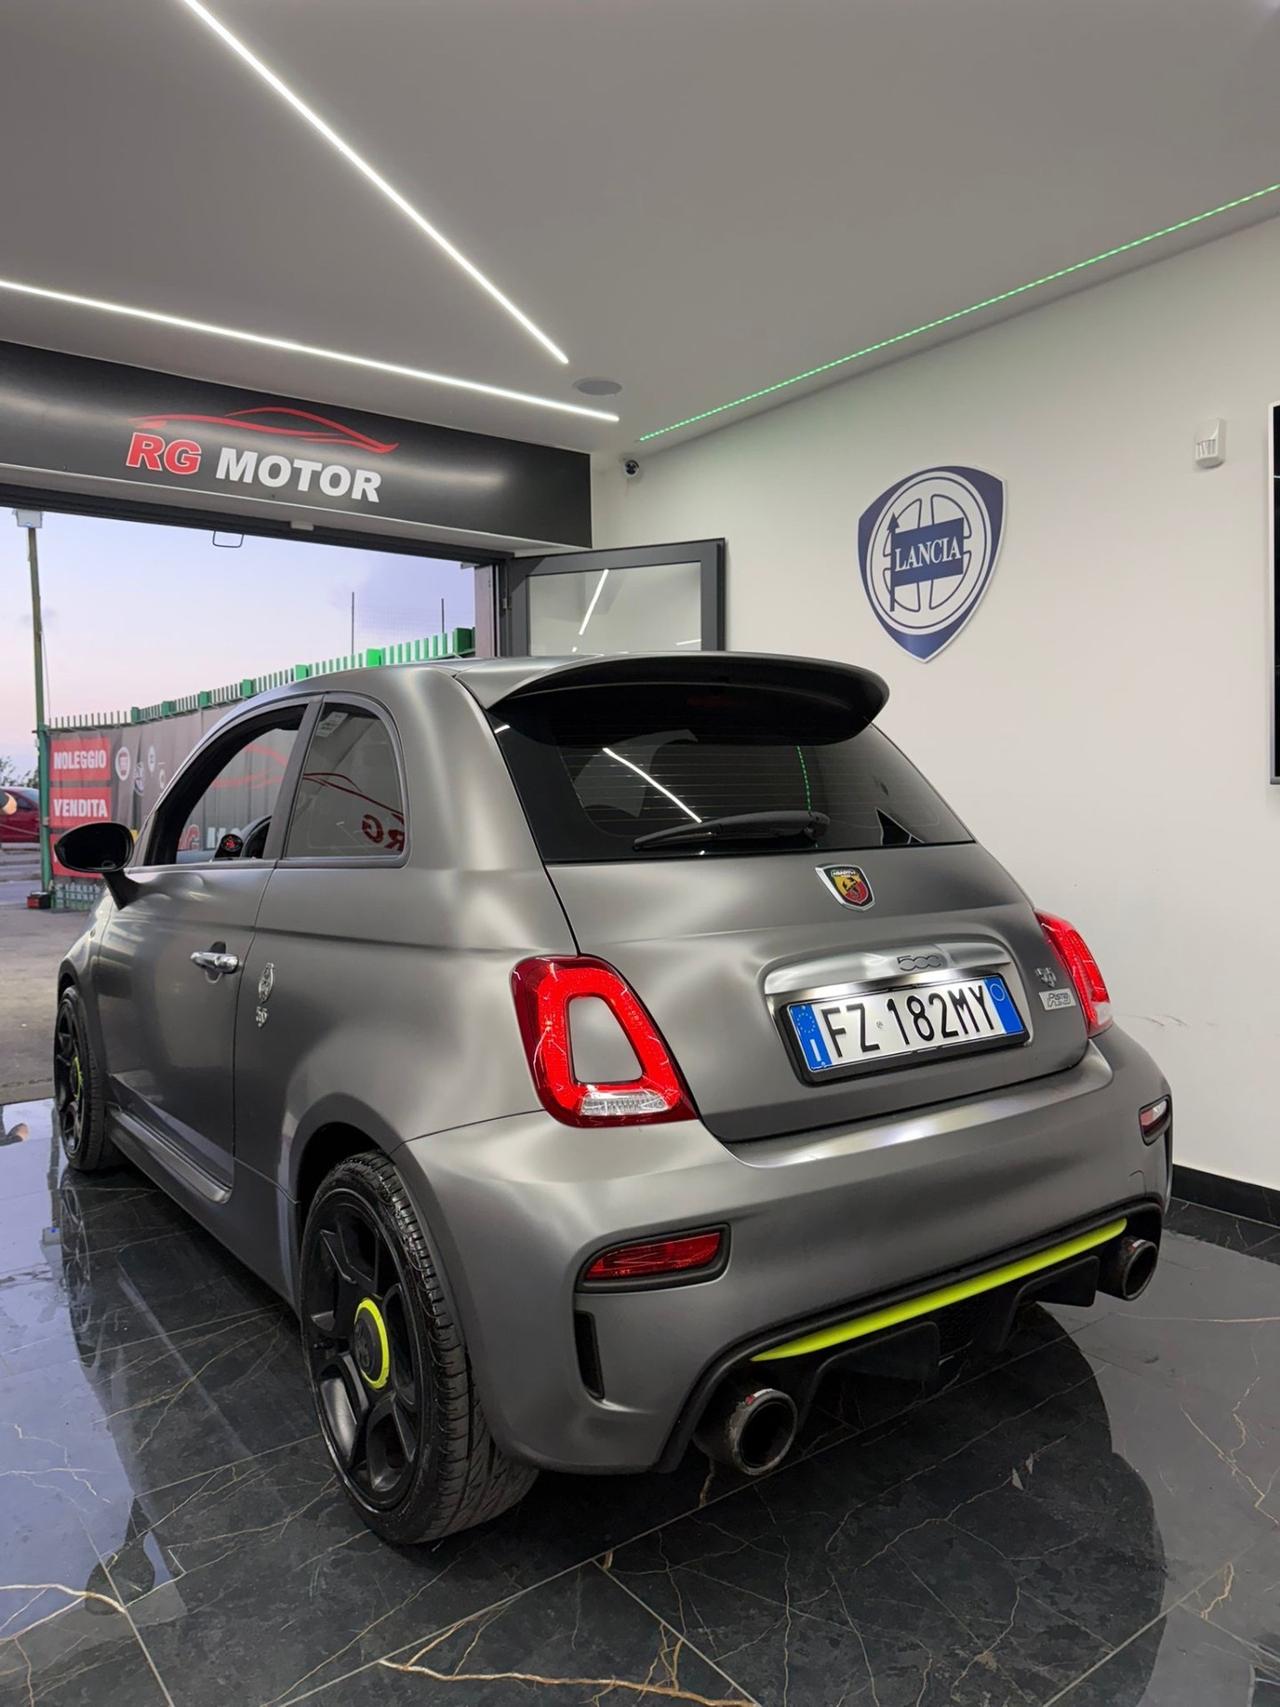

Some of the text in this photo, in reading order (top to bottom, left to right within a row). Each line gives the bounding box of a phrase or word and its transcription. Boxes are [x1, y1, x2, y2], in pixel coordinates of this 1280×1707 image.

[126, 432, 382, 502] RG MOTOR
[894, 536, 961, 572] LANCIA
[53, 750, 107, 769] NOLEGGIO
[53, 799, 108, 817] VENDITA
[897, 954, 942, 972] 500
[820, 985, 995, 1058] FZ 182MY
